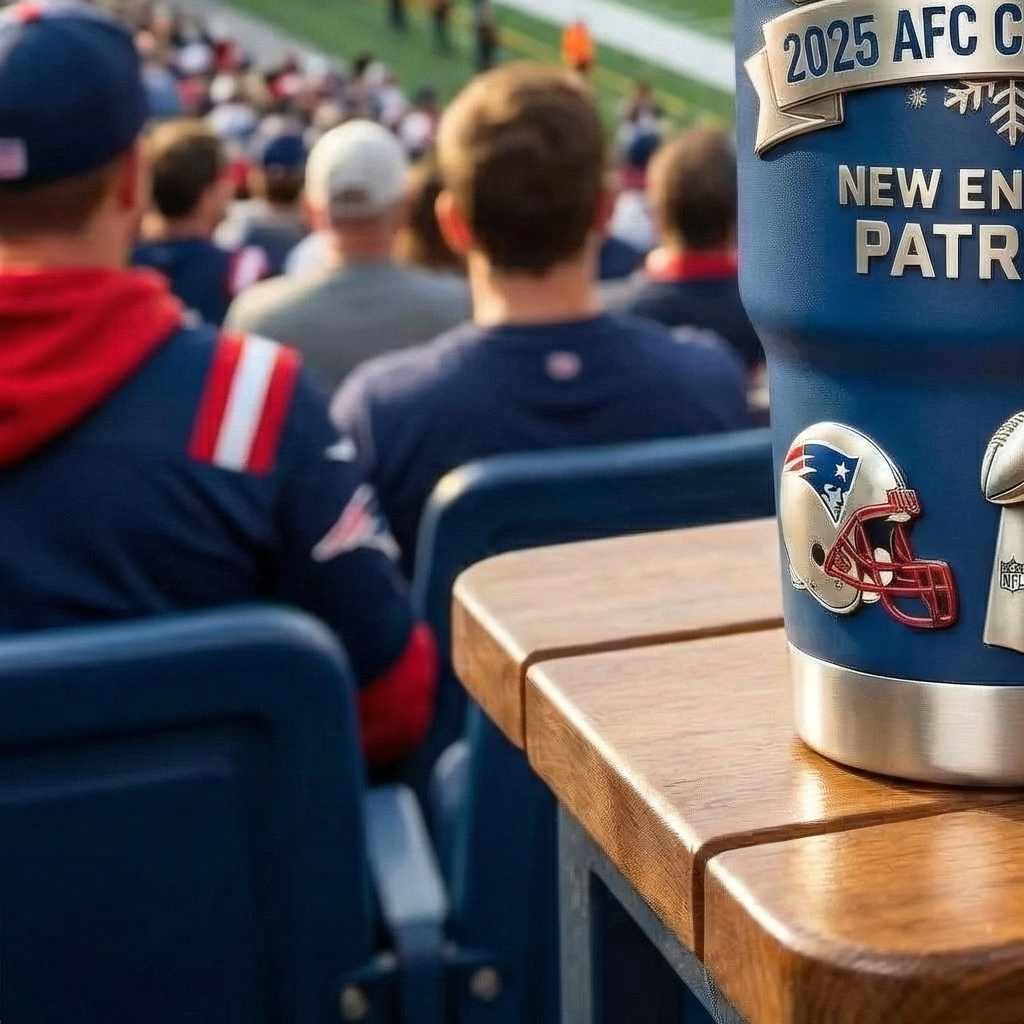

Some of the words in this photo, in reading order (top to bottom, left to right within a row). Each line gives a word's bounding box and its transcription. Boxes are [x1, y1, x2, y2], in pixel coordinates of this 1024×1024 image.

[783, 14, 880, 84] 2025
[892, 2, 978, 63] AFC
[838, 164, 942, 209] NEW
[1002, 573, 1024, 589] NFL
